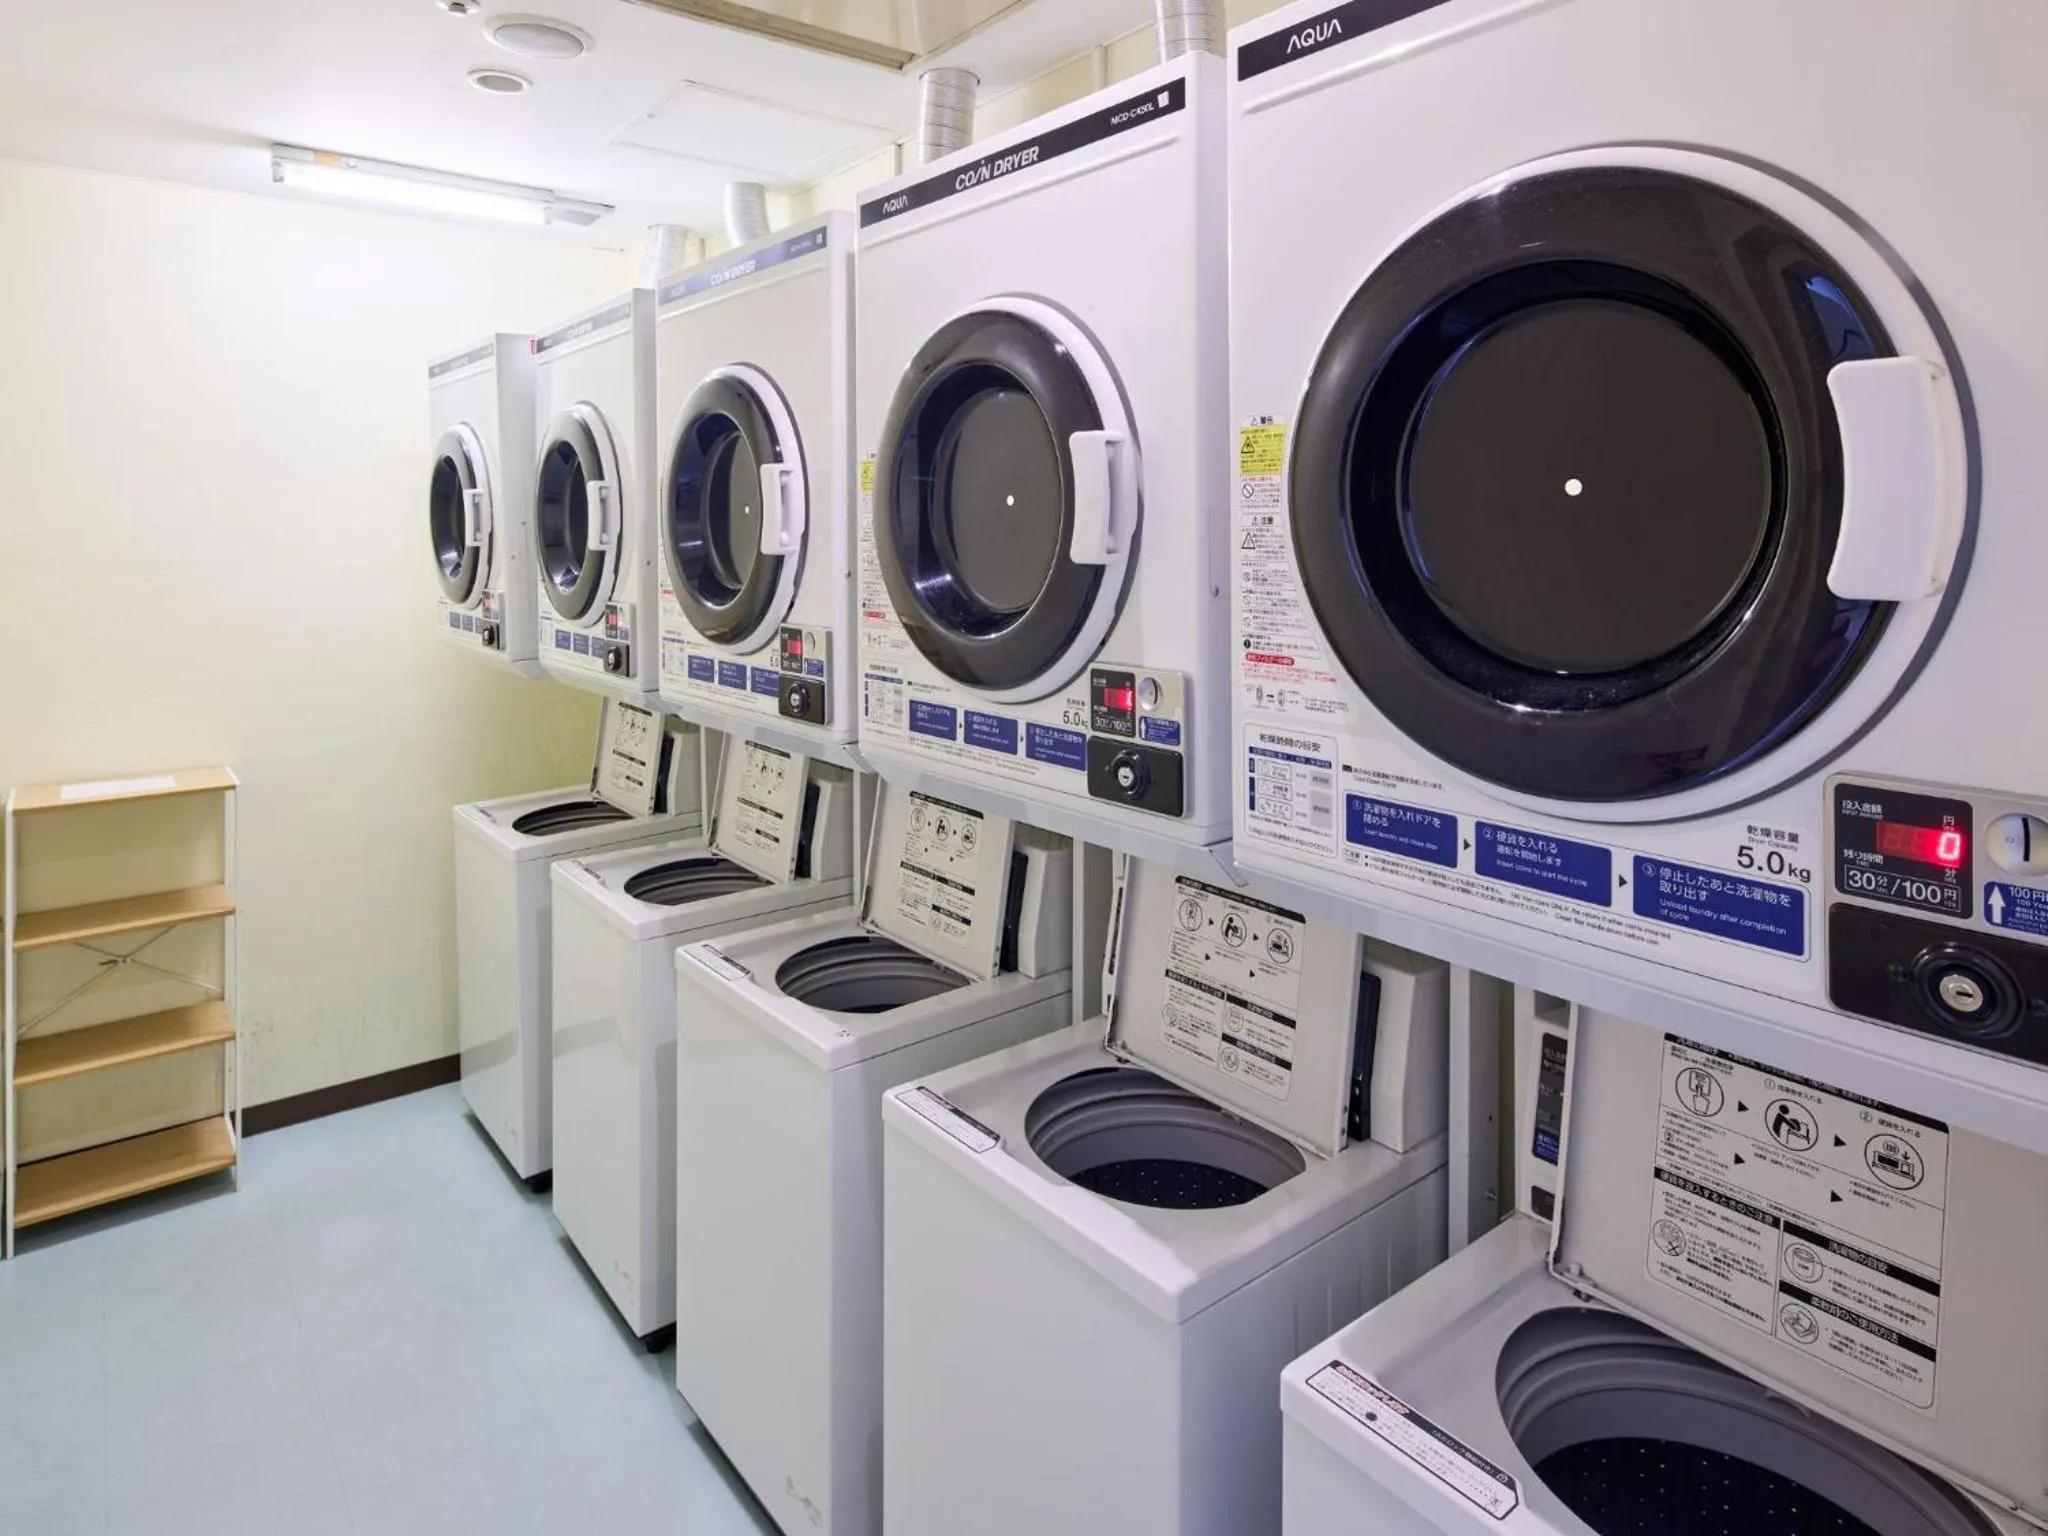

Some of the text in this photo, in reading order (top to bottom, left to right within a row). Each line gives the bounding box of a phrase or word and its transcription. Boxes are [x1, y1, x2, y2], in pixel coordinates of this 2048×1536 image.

[1286, 18, 1343, 54] AQUA
[955, 146, 1040, 191] COIN DRYER
[882, 195, 909, 214] AQUA
[1944, 815, 1955, 826] 円
[1496, 831, 1558, 855] 硬貨を入れる
[1747, 825, 1799, 843] 乾燥容量
[1844, 848, 1884, 865] 残り時間
[1938, 832, 1961, 860] 0
[1737, 845, 1811, 883] 5.0kg
[1659, 866, 1792, 908] 停止したあと洗濯物を
[1659, 880, 1709, 902] 取り出す
[1740, 914, 1787, 936] completion
